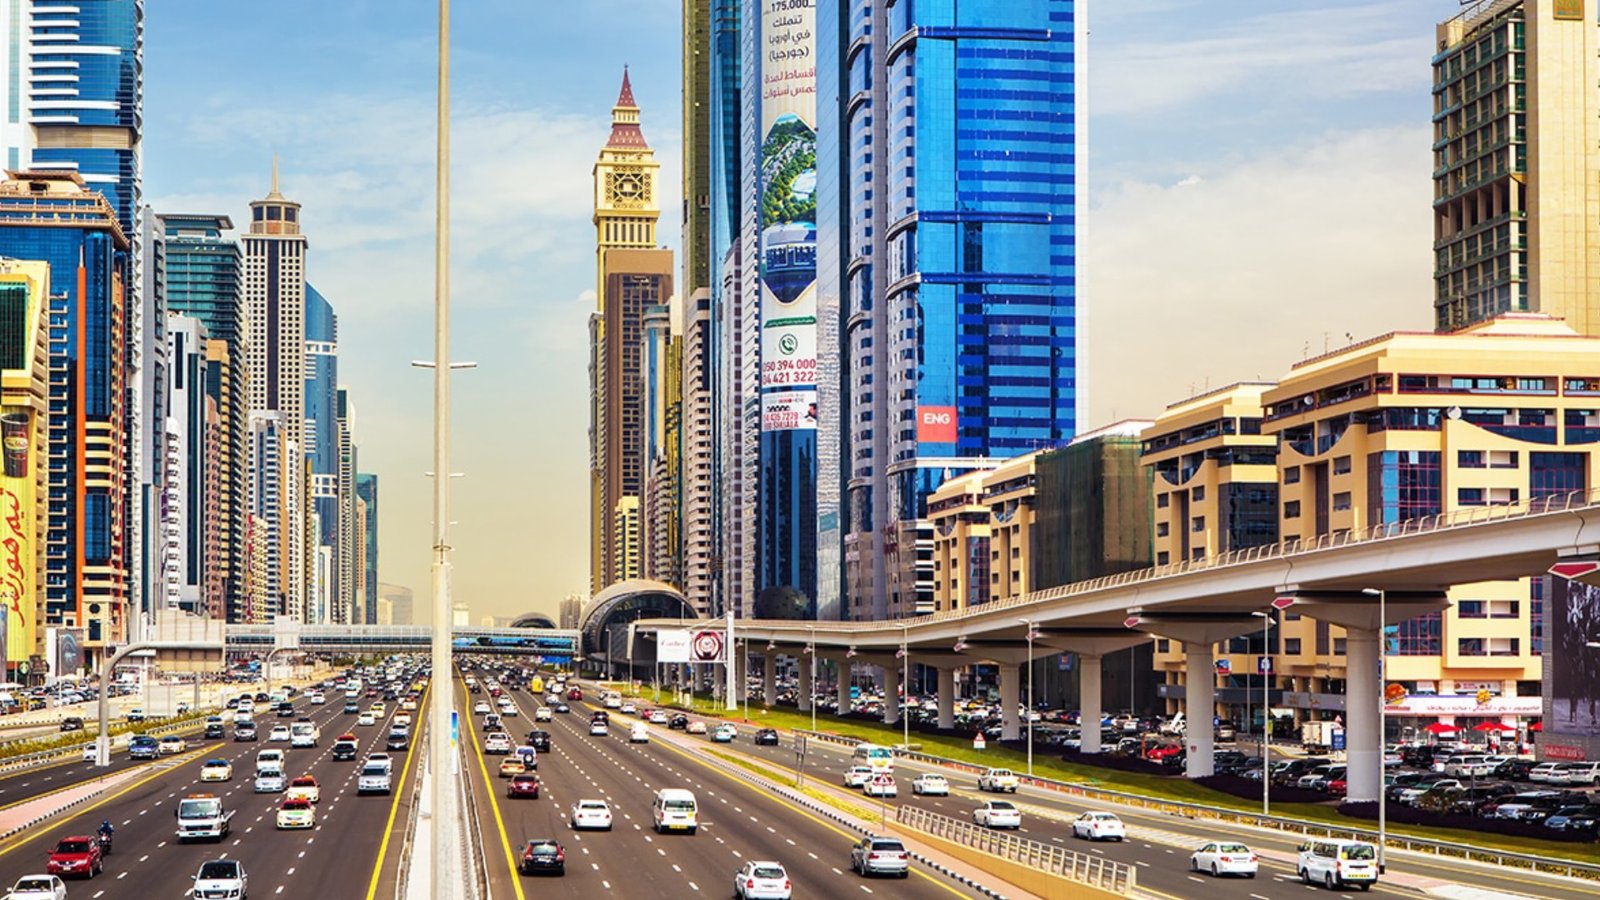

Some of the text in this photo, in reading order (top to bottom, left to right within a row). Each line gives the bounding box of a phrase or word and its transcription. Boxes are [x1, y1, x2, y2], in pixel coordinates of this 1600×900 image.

[791, 29, 811, 45] في
[777, 359, 794, 371] 394
[773, 372, 790, 384] 421
[793, 370, 817, 383] 322
[924, 412, 951, 425] ENG
